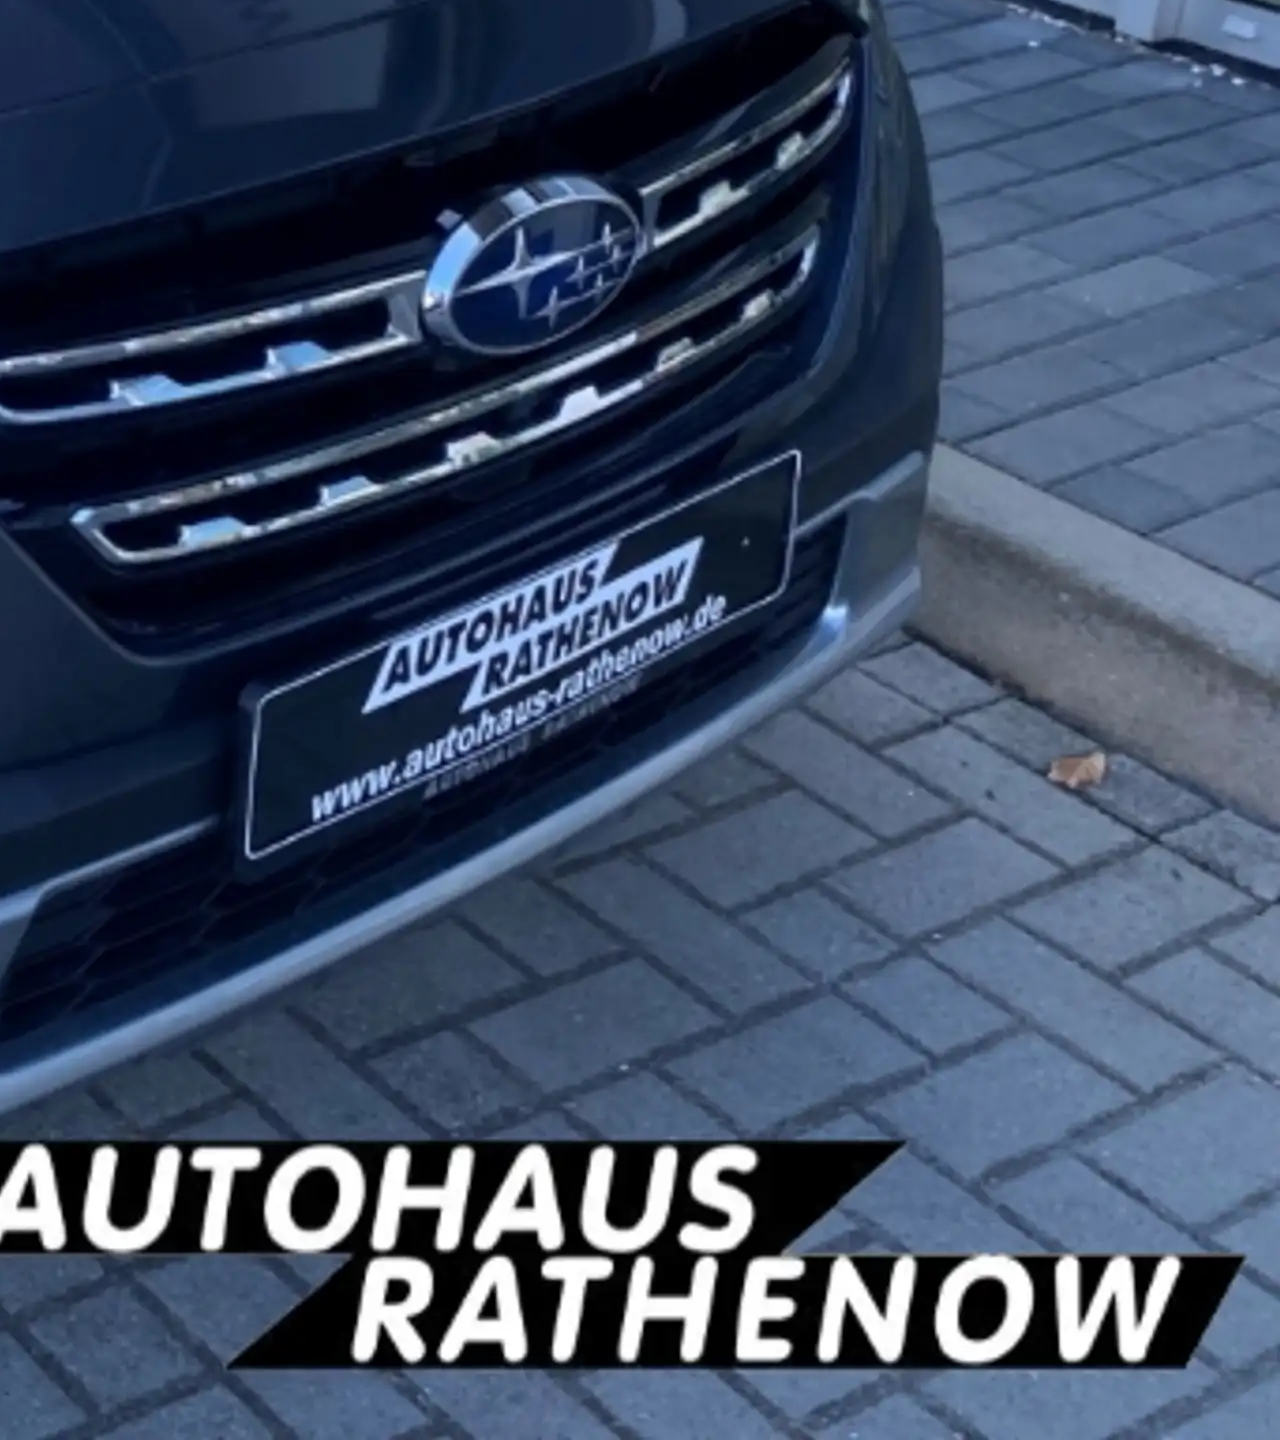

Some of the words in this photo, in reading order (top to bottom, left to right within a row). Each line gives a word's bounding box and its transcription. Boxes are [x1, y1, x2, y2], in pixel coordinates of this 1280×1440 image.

[382, 558, 598, 694] AUTOHAUS
[481, 560, 689, 698] RATHENOW
[310, 593, 727, 823] www.autohaus-rathenow.de
